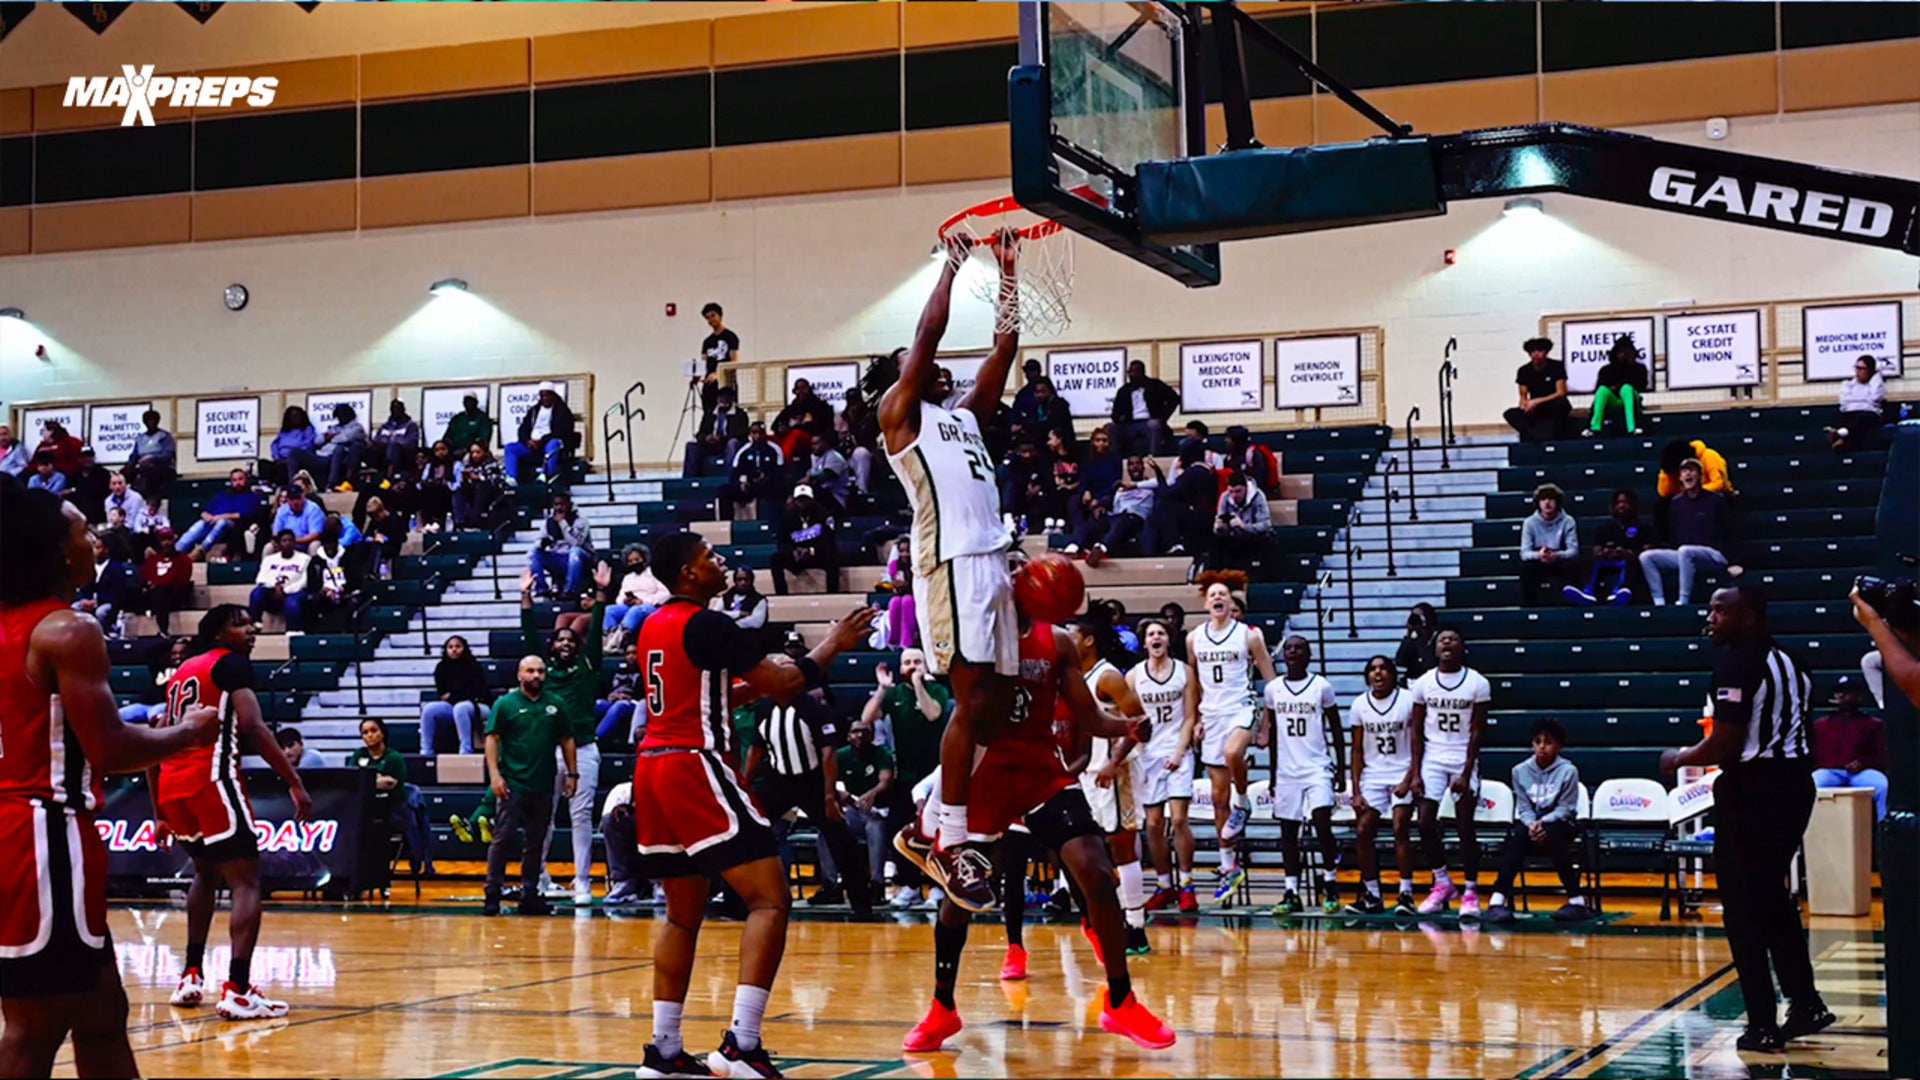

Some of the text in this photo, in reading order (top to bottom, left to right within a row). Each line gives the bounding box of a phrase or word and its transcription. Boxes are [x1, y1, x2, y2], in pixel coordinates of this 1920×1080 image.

[1649, 165, 1893, 238] GARED
[1687, 323, 1737, 337] SC STATE
[1692, 337, 1733, 349] CREDIT
[1815, 331, 1887, 343] MEDICINE MART
[1818, 342, 1884, 354] OF LEXINGTON
[1192, 352, 1251, 364] LEXINGTON
[1571, 347, 1647, 363] PLUMG
[1694, 351, 1732, 363] UNION
[1053, 361, 1120, 376] REYNOLDS
[1199, 365, 1244, 376] MEDICAL
[1294, 361, 1340, 372] HERNDON
[1056, 377, 1117, 391] LAW FIRM
[1202, 378, 1241, 389] CENTER
[1290, 372, 1344, 384] CHEVROLET
[507, 394, 530, 403] CHAD
[112, 413, 128, 421] THE
[205, 411, 249, 422] SECURITY
[100, 422, 140, 432] PALMETTO
[206, 425, 247, 435] FEDERAL
[105, 442, 132, 451] GROUP
[214, 437, 240, 447] BANK
[1197, 651, 1239, 663] GRAYSON
[1212, 665, 1224, 683] 0
[648, 649, 664, 716] 5
[1141, 691, 1183, 703] GRAYSON
[1426, 697, 1473, 709] GRAYSON
[1156, 705, 1173, 723] 12
[1277, 702, 1317, 714] GRAYSON
[1286, 717, 1307, 737] 20
[1437, 713, 1461, 733] 22
[1376, 736, 1397, 755] 23
